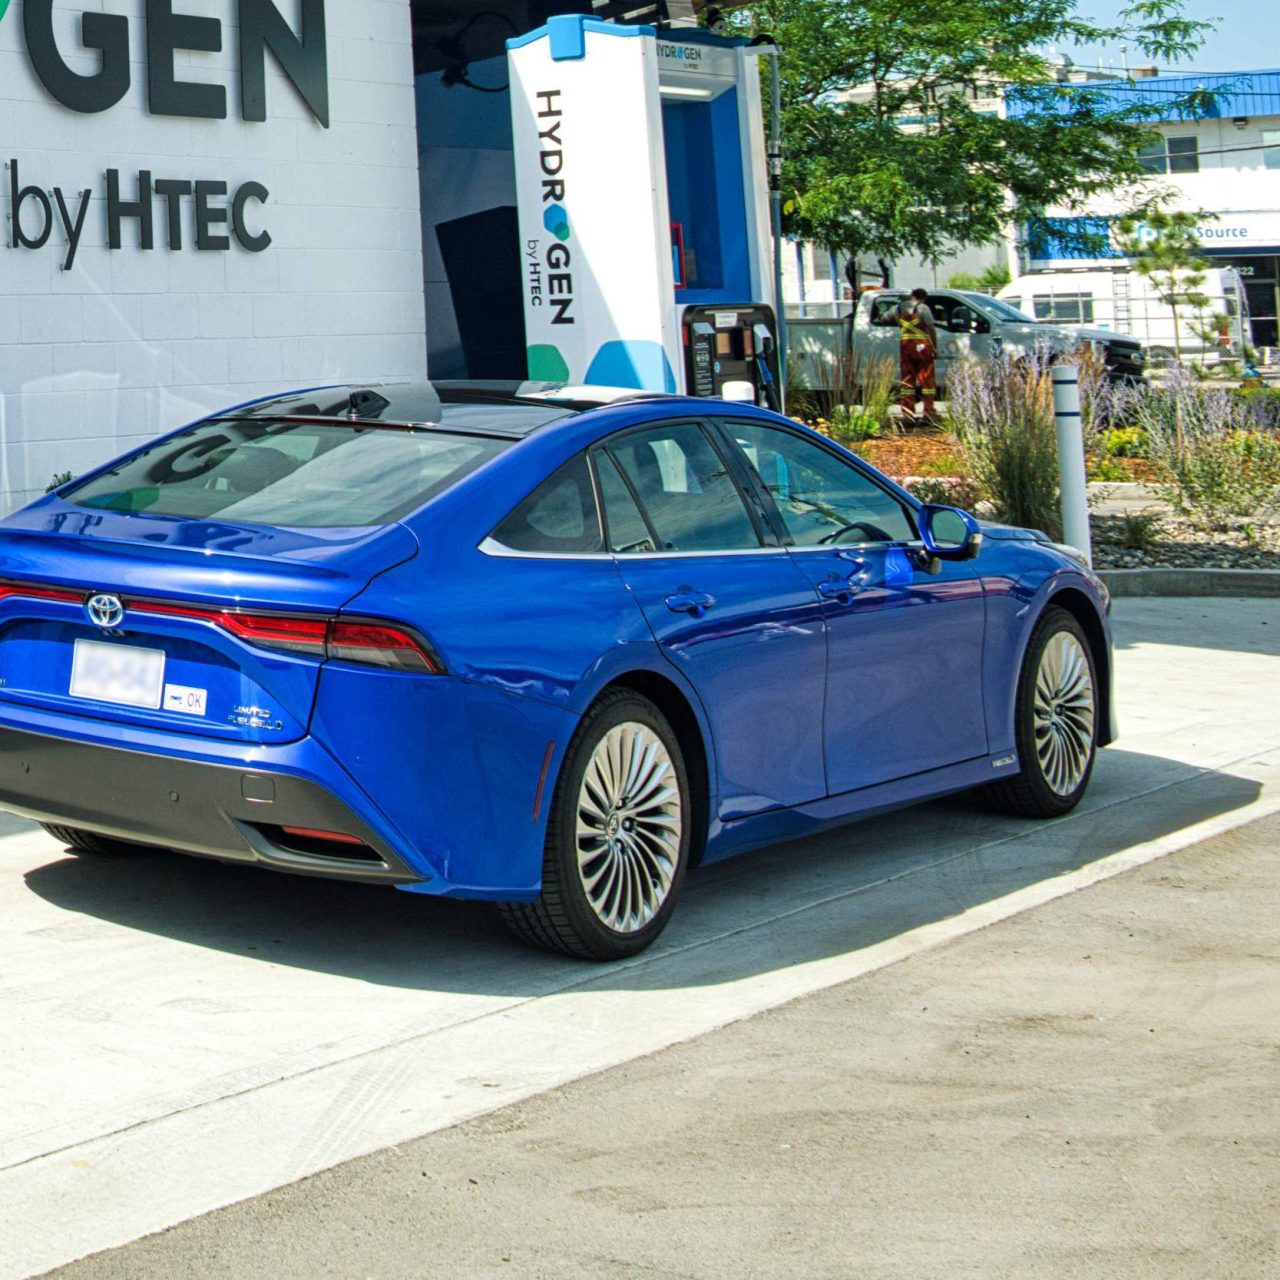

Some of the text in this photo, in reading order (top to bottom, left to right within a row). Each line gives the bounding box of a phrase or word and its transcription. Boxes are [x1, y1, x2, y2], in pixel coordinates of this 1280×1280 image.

[10, 158, 272, 270] by HTEC
[536, 89, 575, 325] HYDROGEN
[1196, 226, 1248, 238] Source
[526, 239, 542, 306] by HTEC
[187, 693, 201, 708] OK
